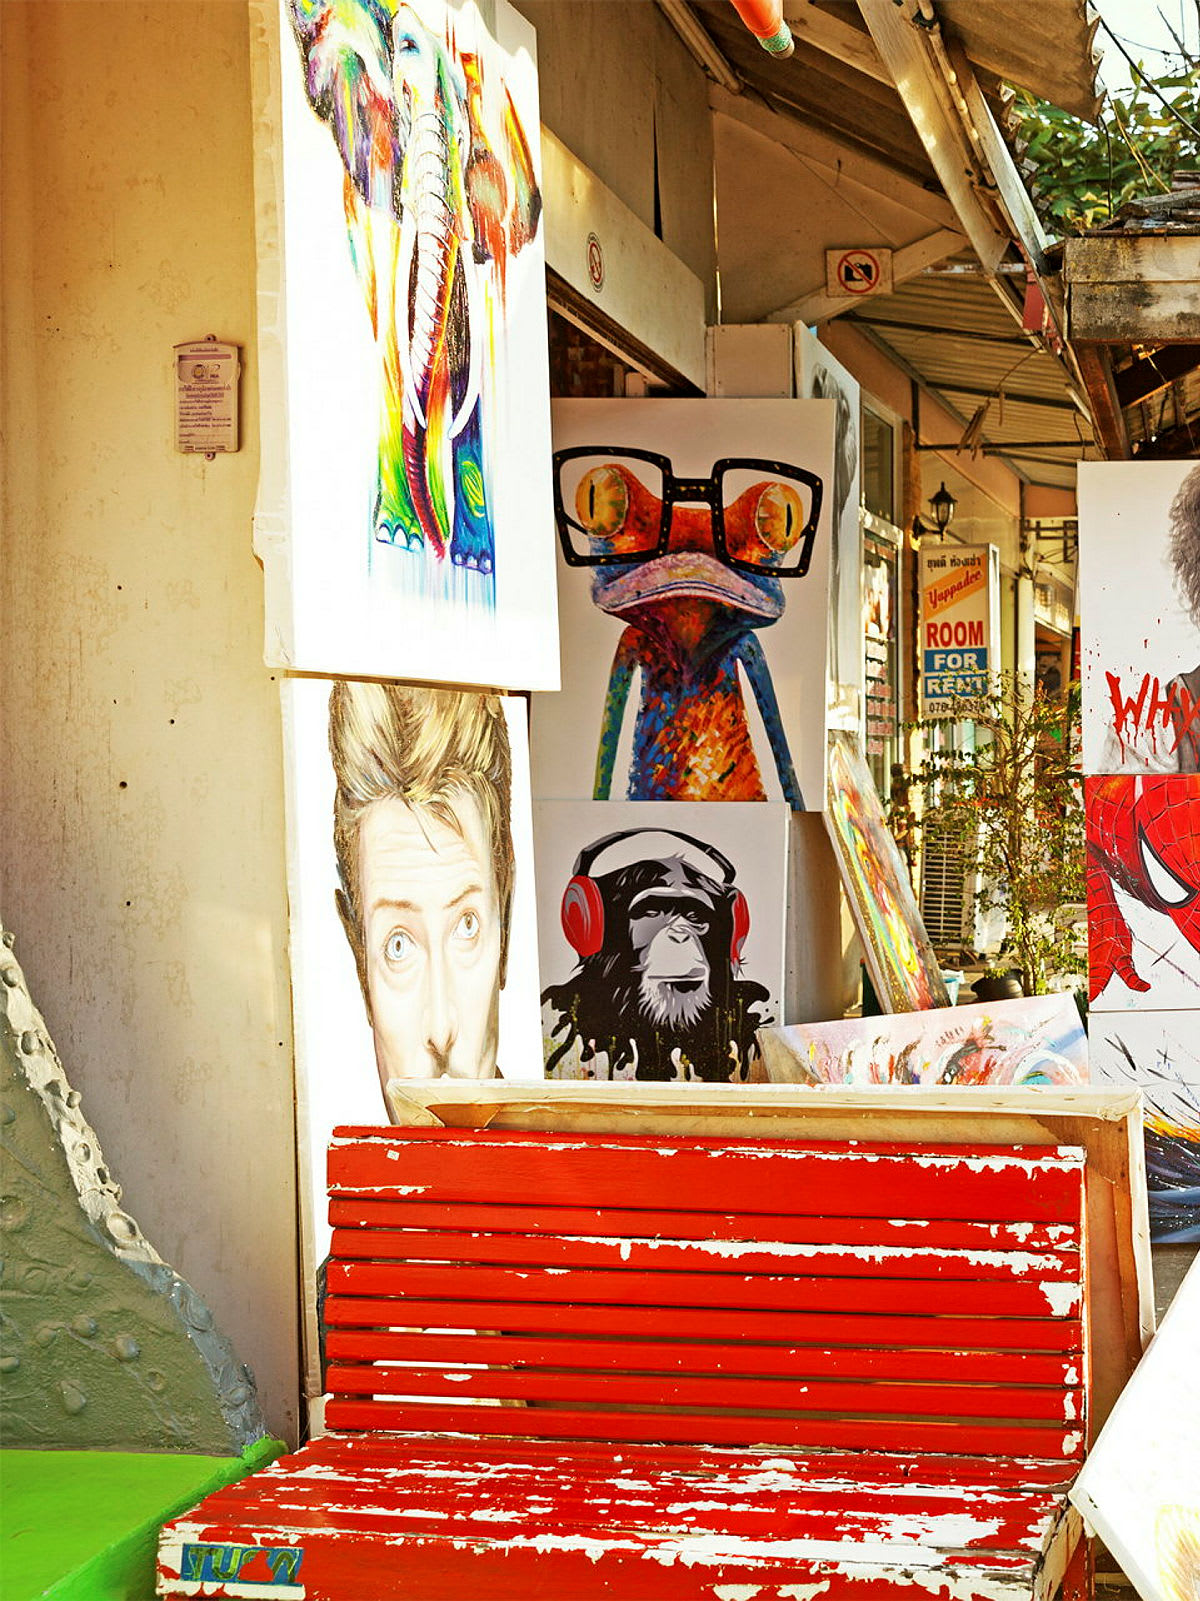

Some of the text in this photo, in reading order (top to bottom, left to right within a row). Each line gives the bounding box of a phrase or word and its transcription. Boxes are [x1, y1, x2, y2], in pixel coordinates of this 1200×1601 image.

[926, 569, 983, 609] Yuppadee
[926, 620, 985, 648] ROOM
[933, 652, 980, 671] FOR
